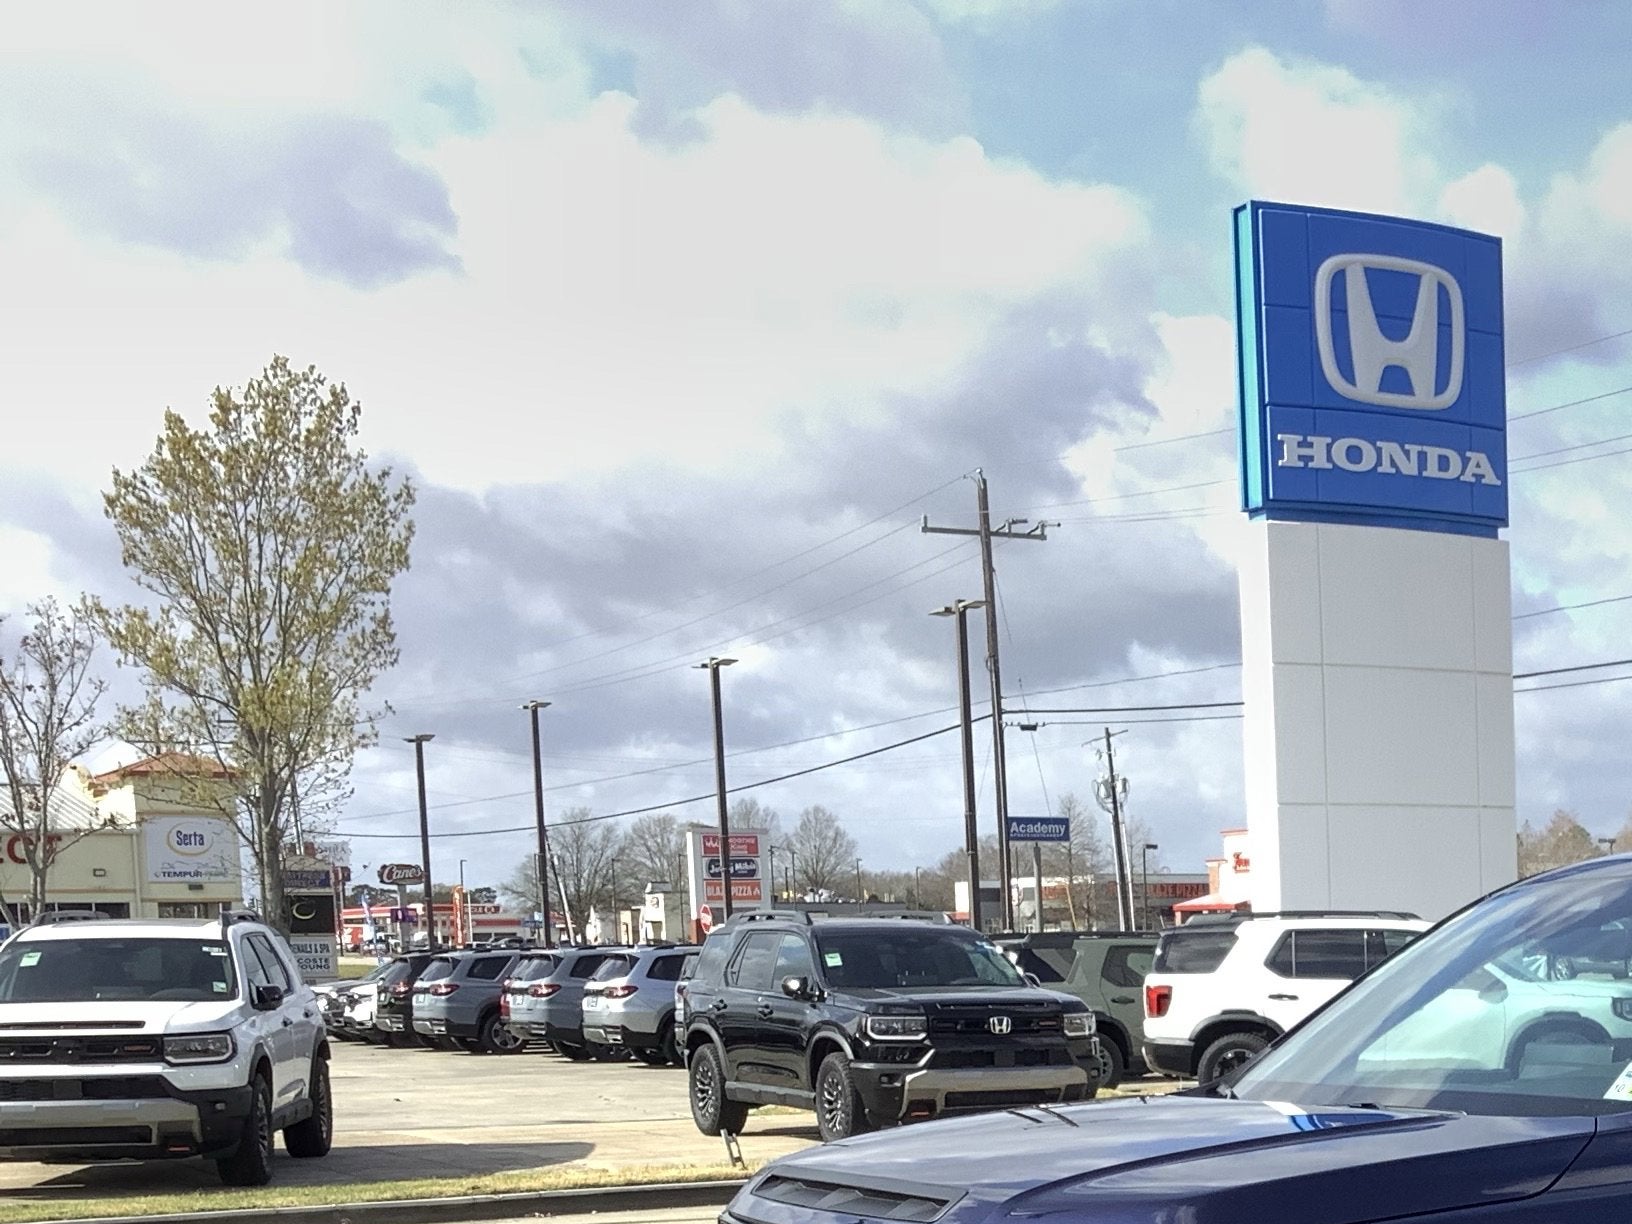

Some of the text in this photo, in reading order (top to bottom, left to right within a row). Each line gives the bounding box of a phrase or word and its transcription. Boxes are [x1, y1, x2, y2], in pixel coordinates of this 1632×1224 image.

[1277, 433, 1502, 487] HONDA
[1010, 821, 1066, 837] Academy
[176, 830, 205, 846] Serta
[731, 885, 752, 897] PIZZA
